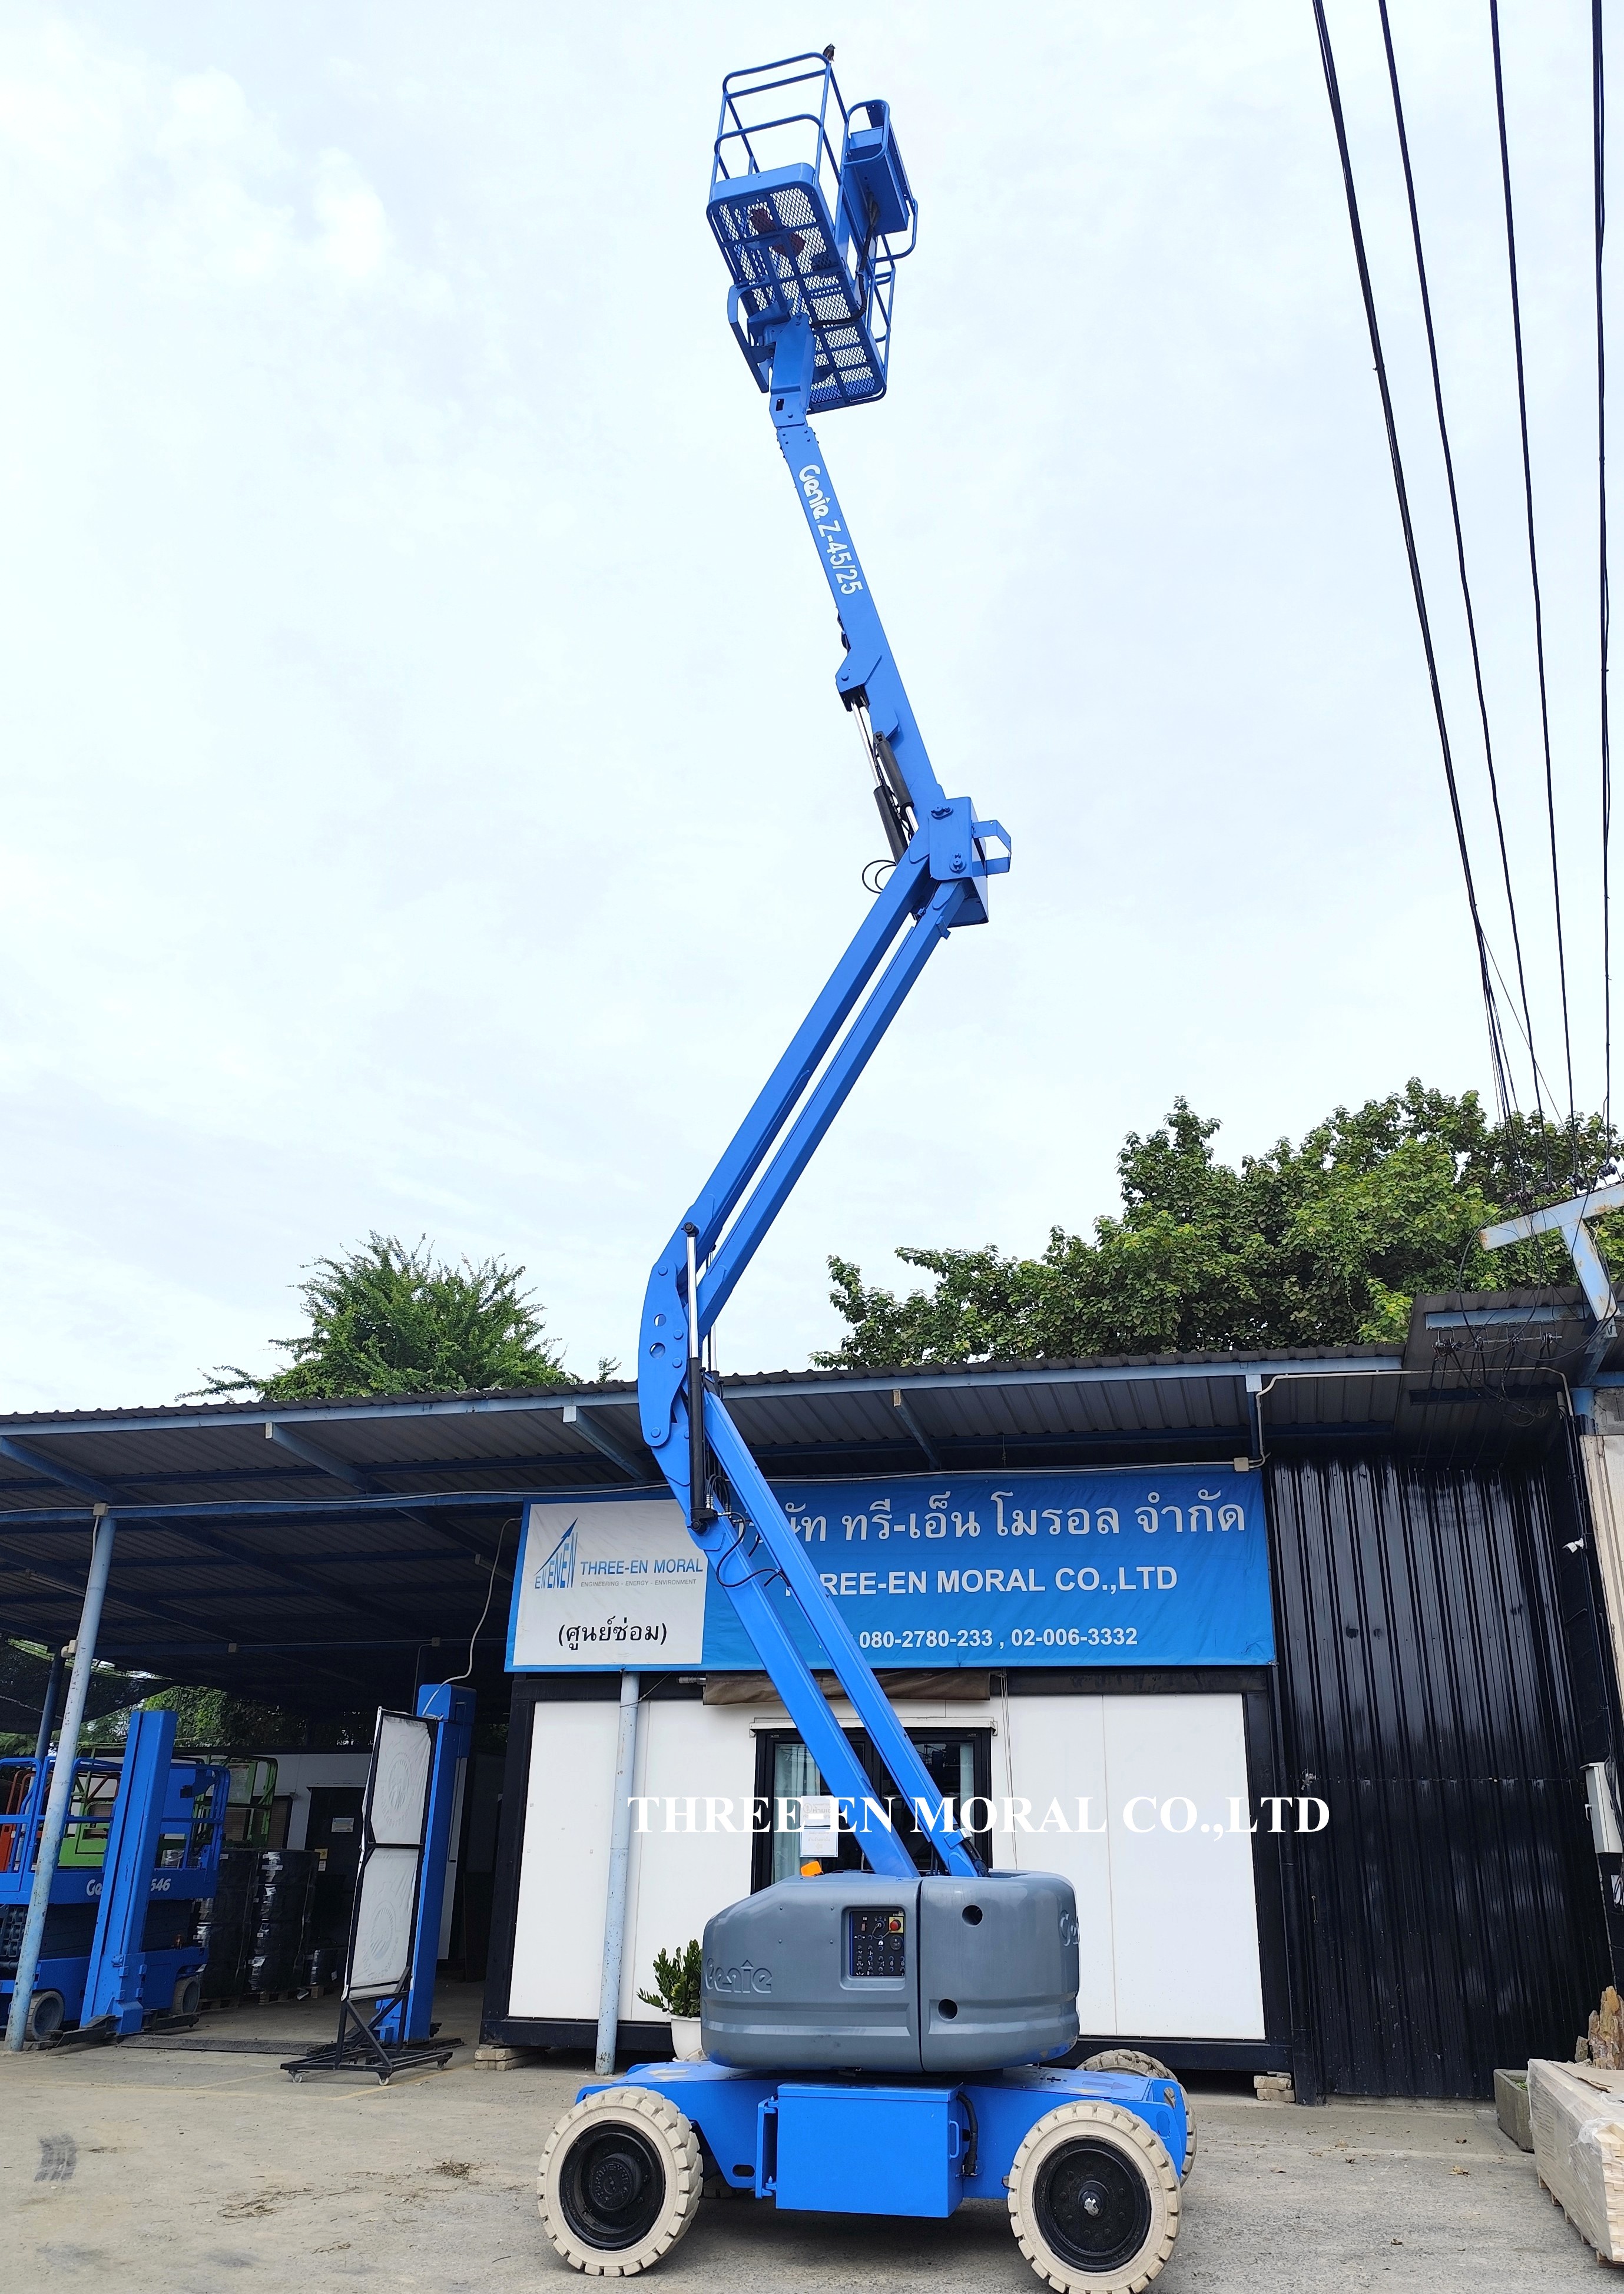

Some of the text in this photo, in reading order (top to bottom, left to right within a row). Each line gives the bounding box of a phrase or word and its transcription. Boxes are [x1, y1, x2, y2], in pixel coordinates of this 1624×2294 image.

[799, 465, 863, 595] Genie Z-45/25
[841, 1491, 980, 1541] ทรี-เอ็น
[990, 1491, 1119, 1536] โมรอล
[1134, 1489, 1245, 1533] จำกัด
[580, 1558, 703, 1576] THREE-EN MORAL
[786, 1566, 1177, 1596] REE-EN MORAL CO.,LTD
[558, 1616, 667, 1650] (ศูนย์ซ่อม)
[859, 1629, 993, 1649] 080-2780-233
[1010, 1627, 1138, 1646] 02-006-3332
